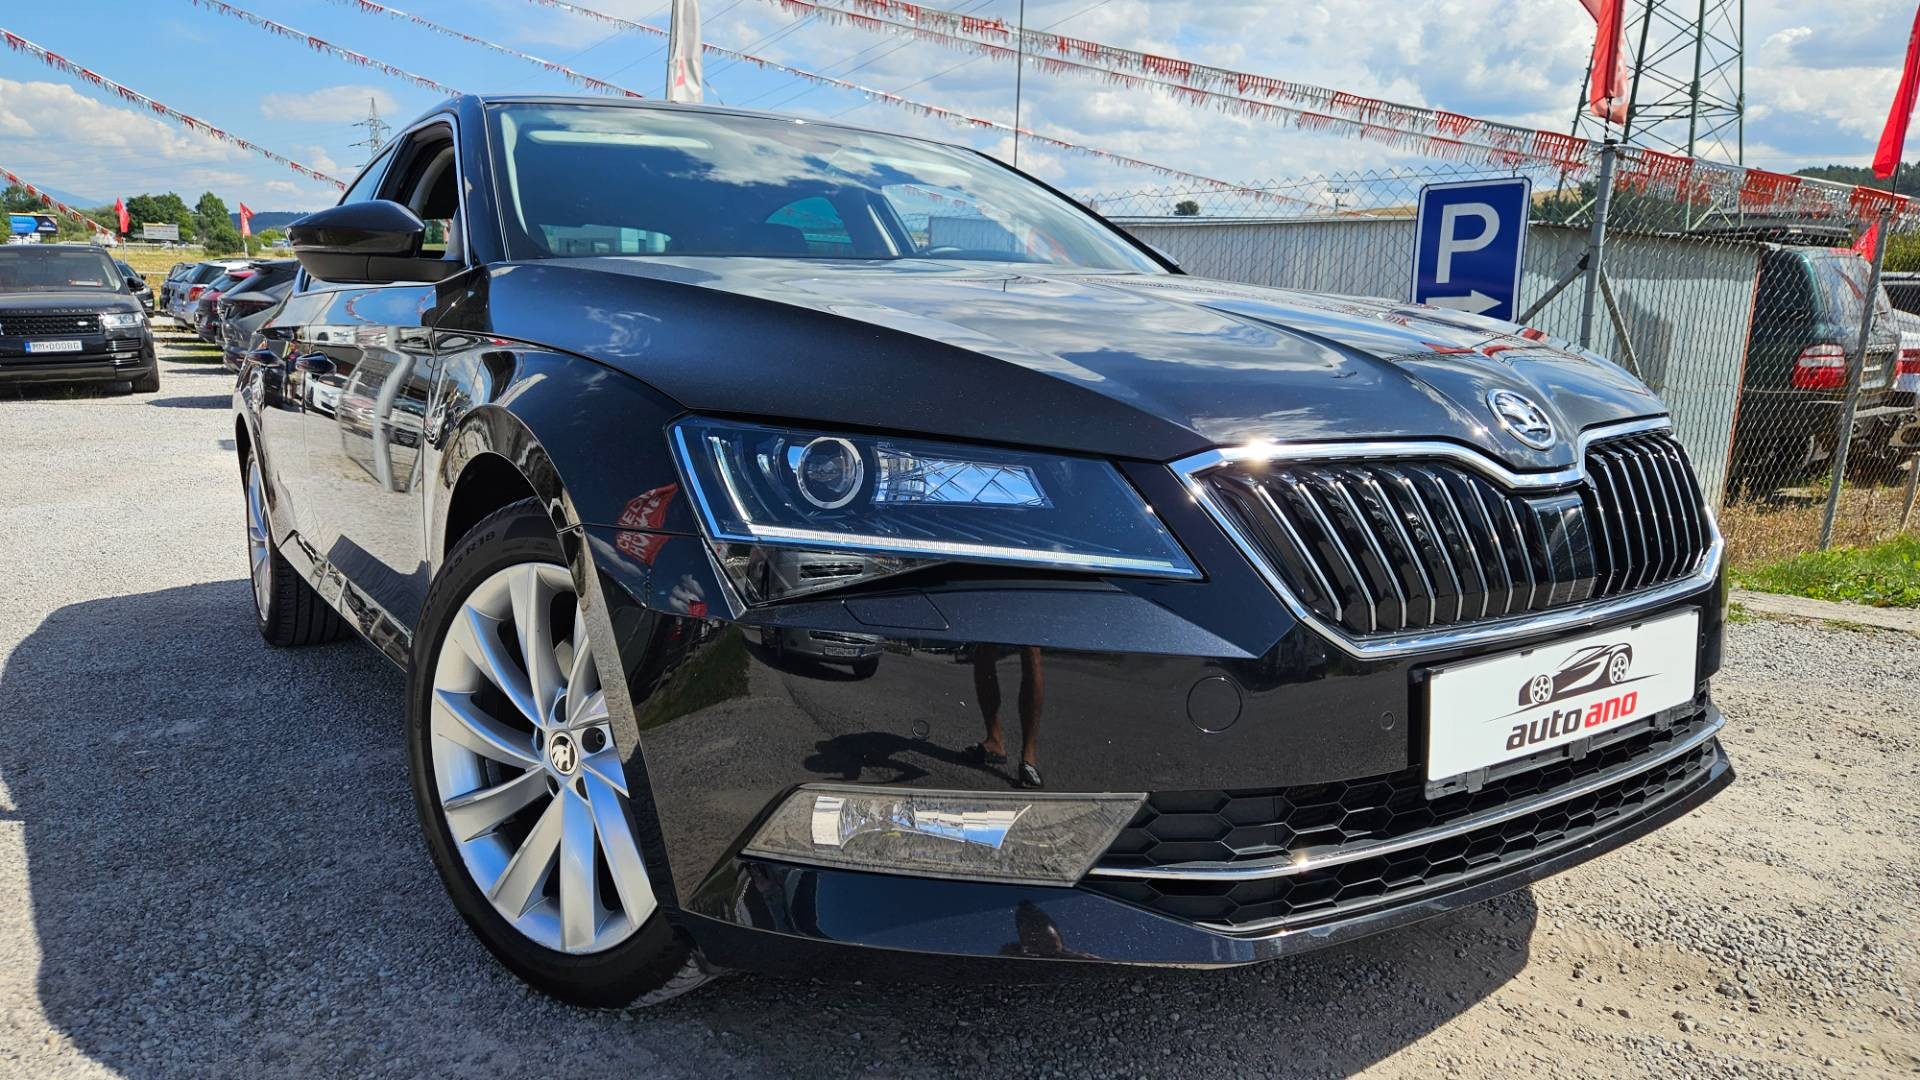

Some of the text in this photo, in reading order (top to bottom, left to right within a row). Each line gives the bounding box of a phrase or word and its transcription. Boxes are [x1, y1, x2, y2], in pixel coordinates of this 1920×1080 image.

[1436, 202, 1500, 283] P
[1506, 691, 1638, 750] auto ano
